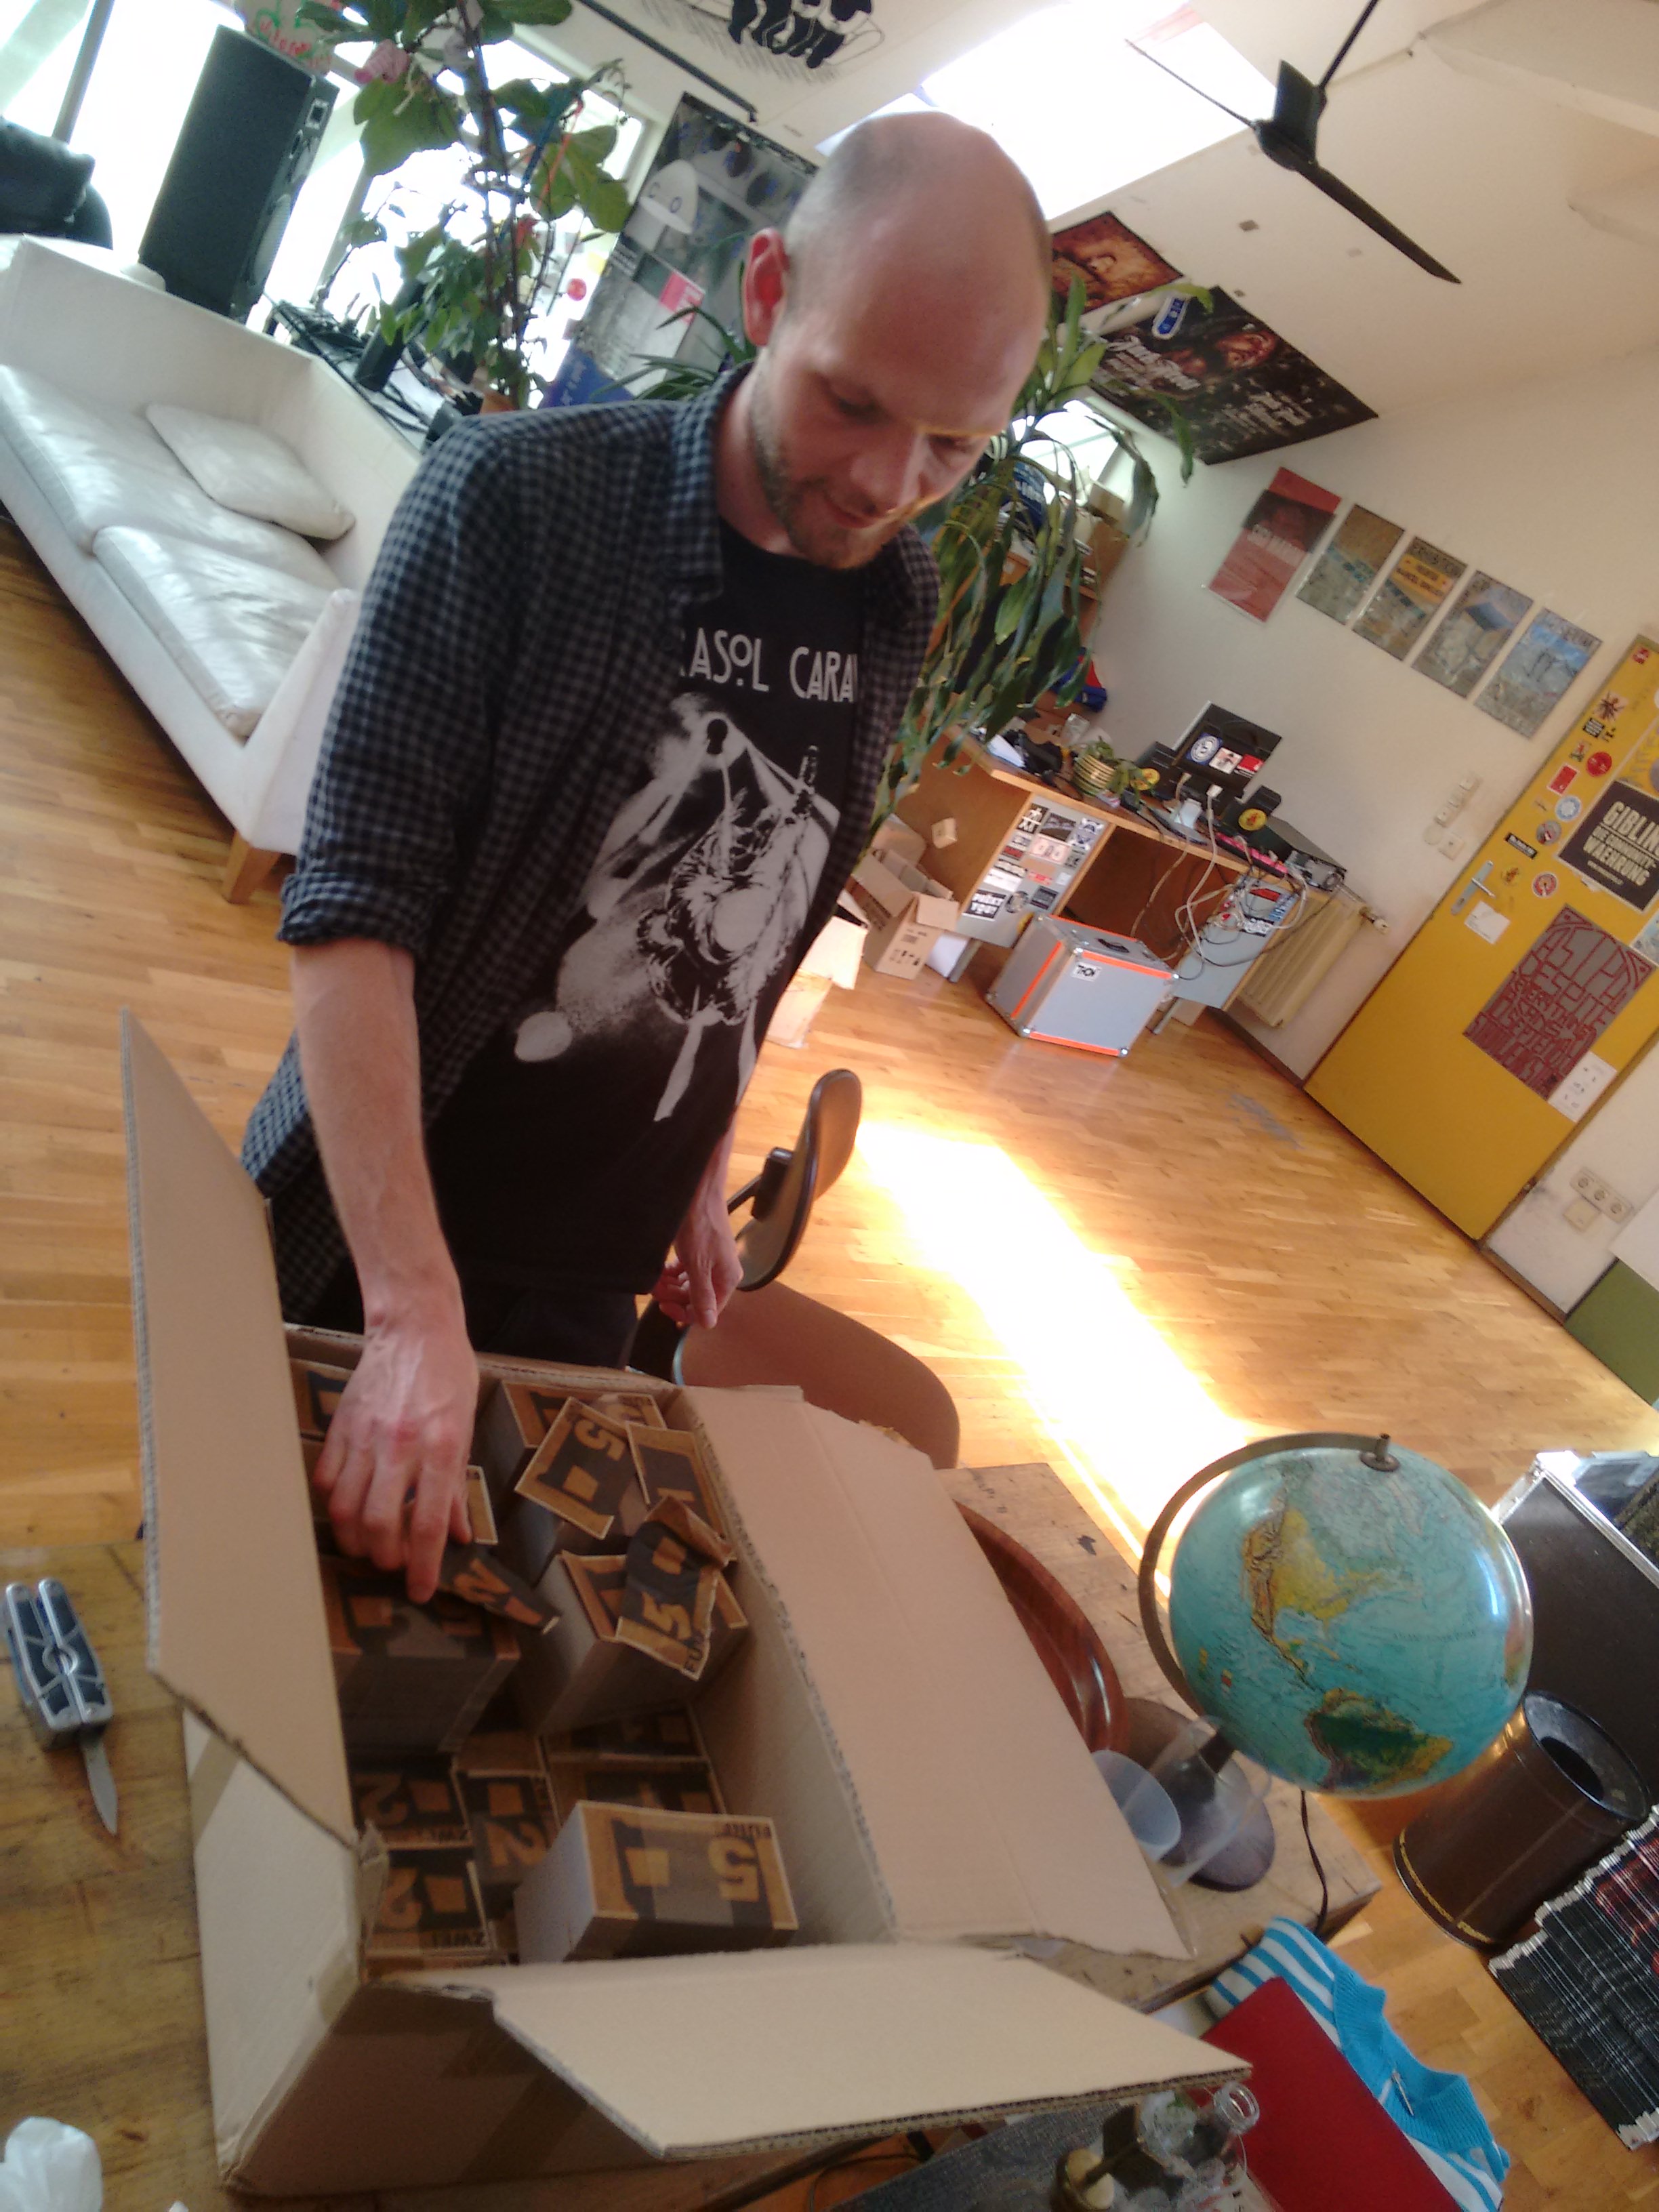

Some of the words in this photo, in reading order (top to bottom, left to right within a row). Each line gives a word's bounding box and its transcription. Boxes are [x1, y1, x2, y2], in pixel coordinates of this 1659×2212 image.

[680, 628, 770, 692] ASOL
[1582, 834, 1650, 886] WAEHRUNG
[706, 1837, 760, 1902] 5
